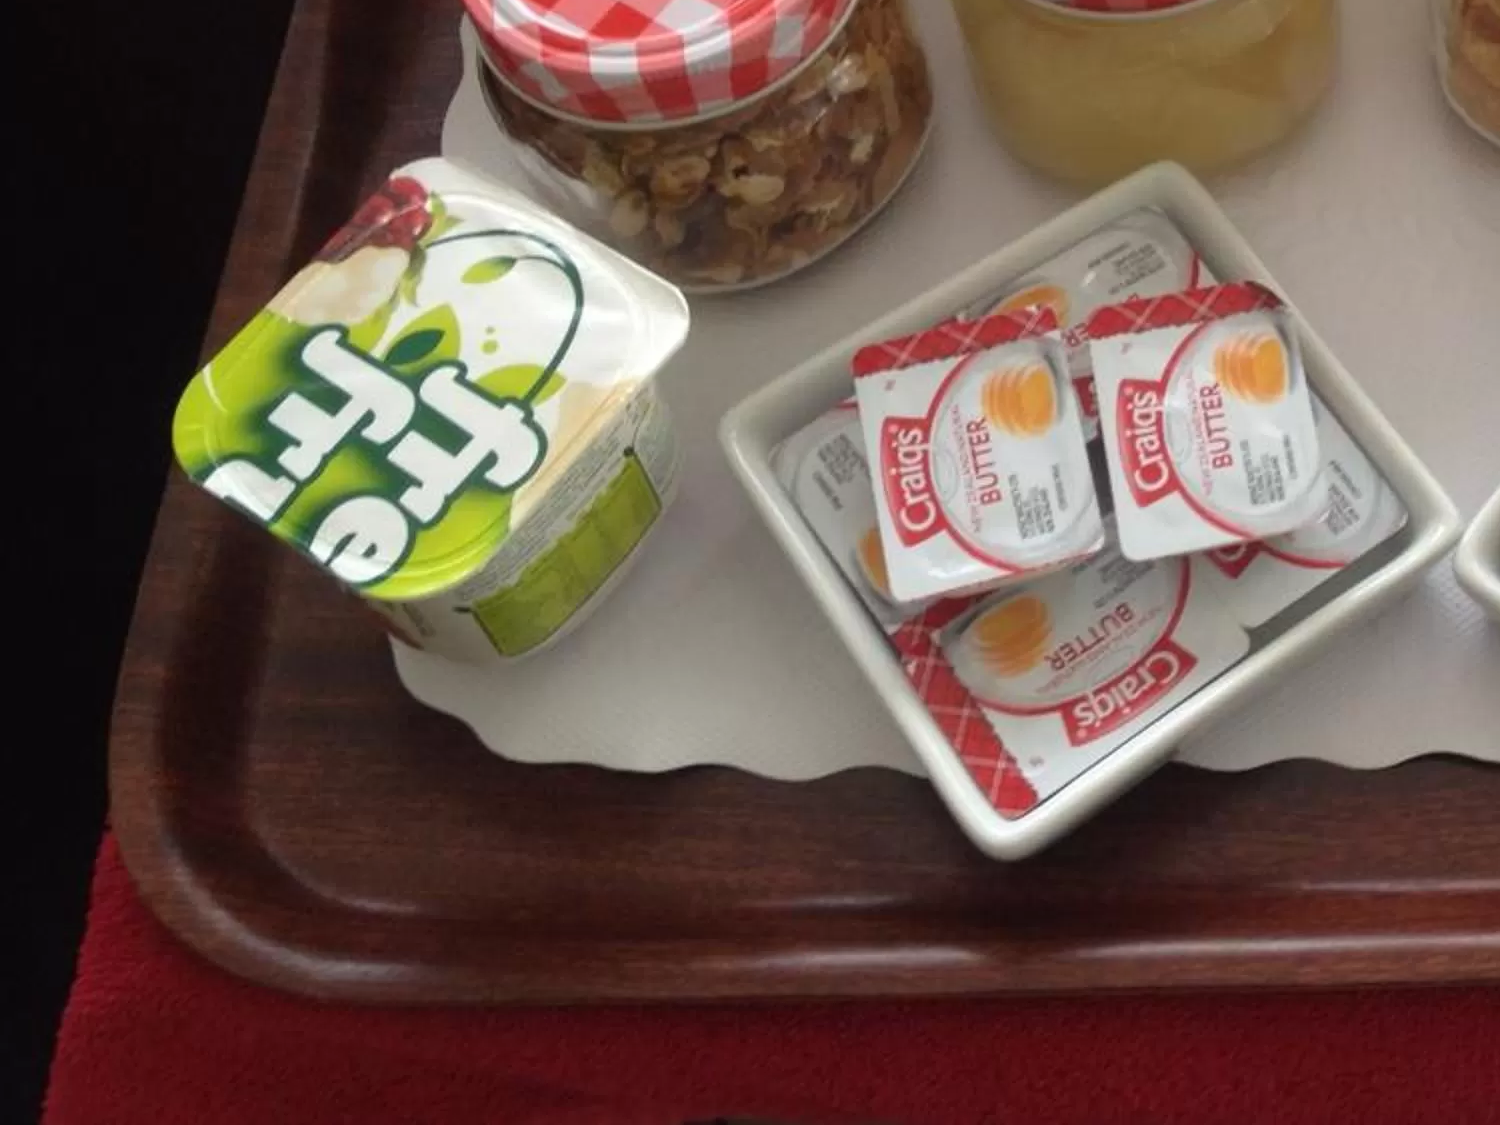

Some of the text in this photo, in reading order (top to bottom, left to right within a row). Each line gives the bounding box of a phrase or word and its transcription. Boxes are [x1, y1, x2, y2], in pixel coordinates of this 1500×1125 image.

[965, 414, 1003, 507] BUTTER
[1125, 389, 1170, 492] Craig's
[1200, 381, 1235, 470] BUTTER
[889, 426, 938, 532] Craig's
[1043, 601, 1135, 672] BUTTER
[1071, 649, 1182, 728] Craig's
